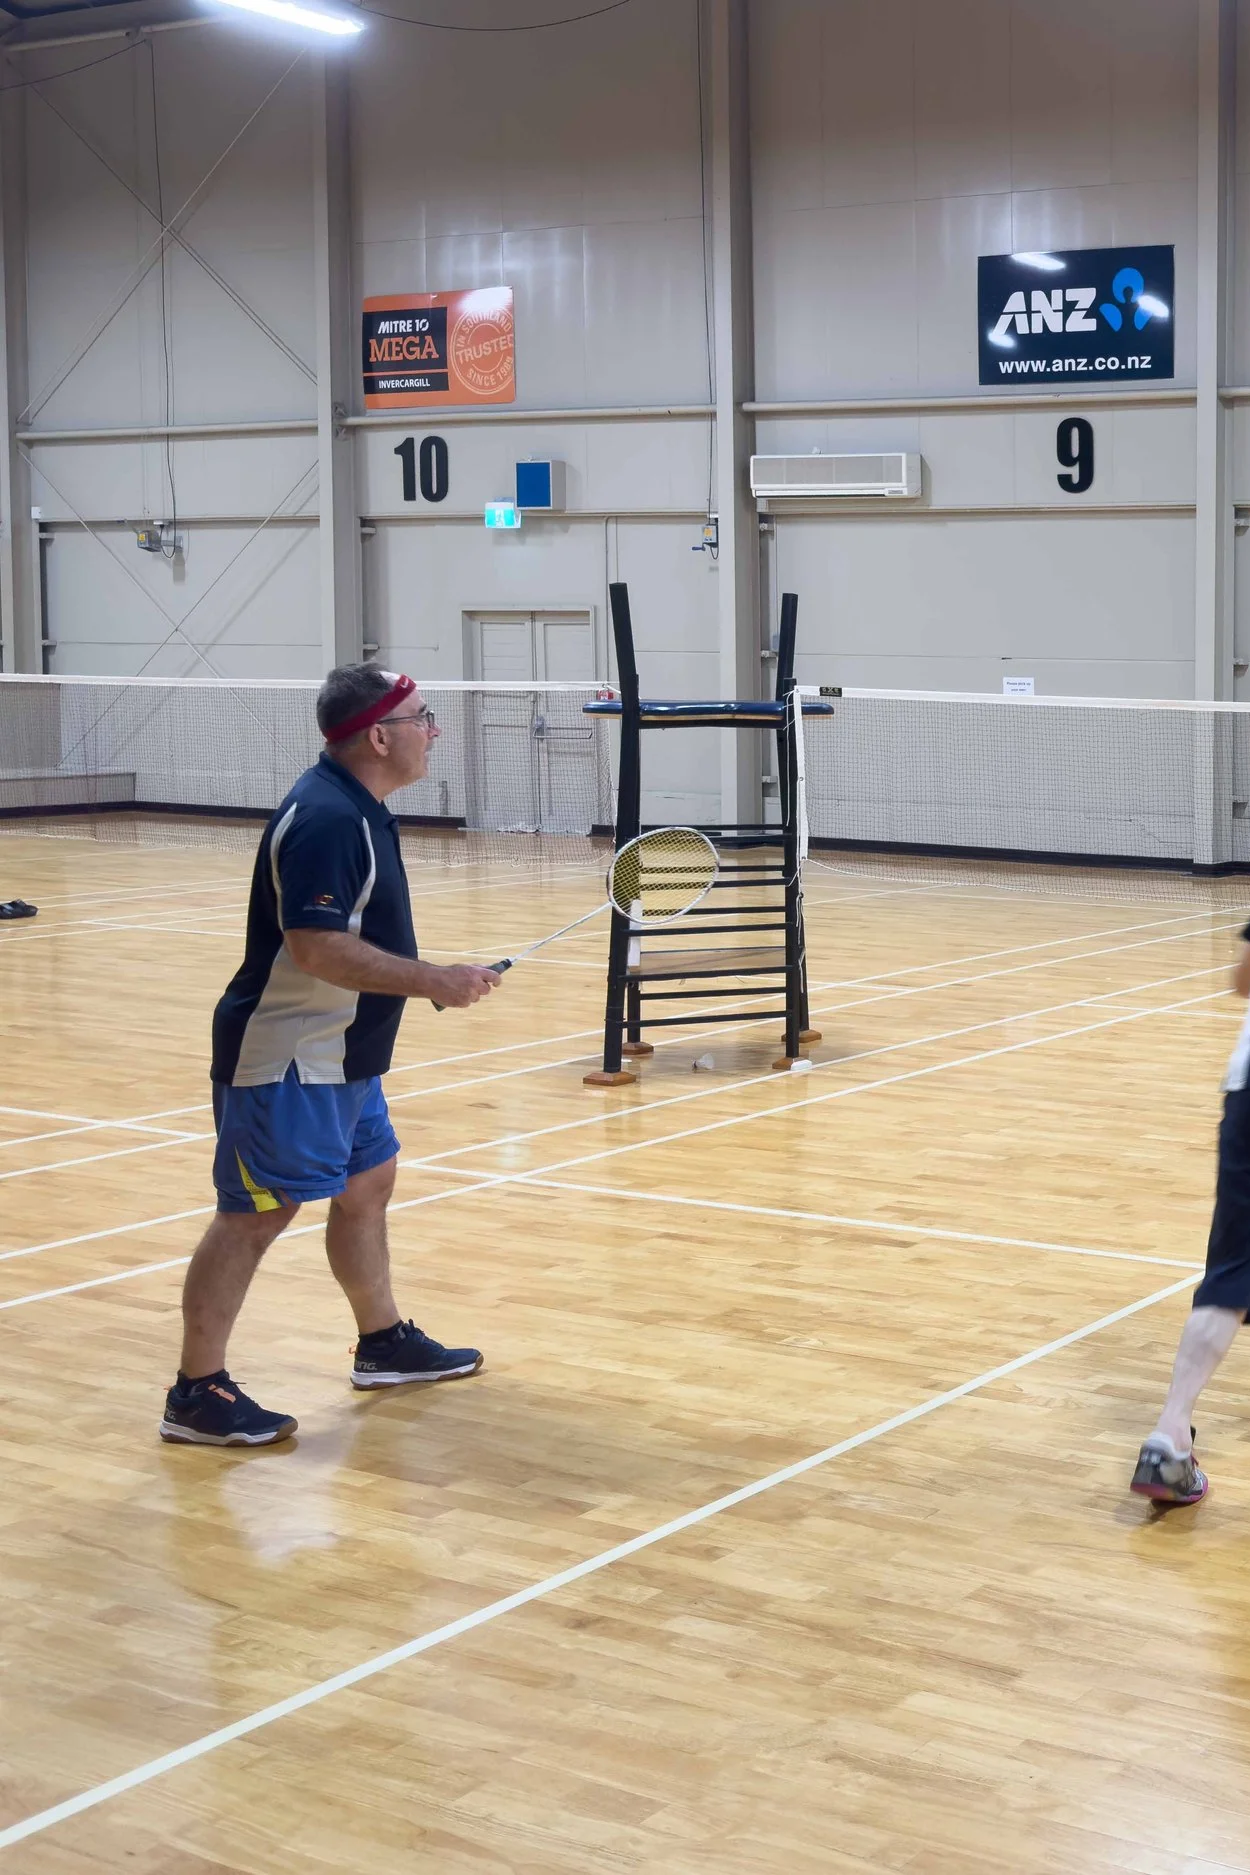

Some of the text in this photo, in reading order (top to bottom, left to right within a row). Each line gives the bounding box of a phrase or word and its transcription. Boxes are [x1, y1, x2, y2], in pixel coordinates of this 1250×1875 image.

[993, 287, 1097, 336] ANZ
[378, 318, 429, 334] MITRE 10
[369, 335, 439, 362] MEGA
[456, 335, 467, 348] IN
[999, 354, 1152, 374] www.anz.co.nz
[379, 377, 430, 389] INVERCARGILL
[466, 368, 497, 387] SINCE
[1056, 417, 1094, 493] 9
[394, 435, 449, 502] 10
